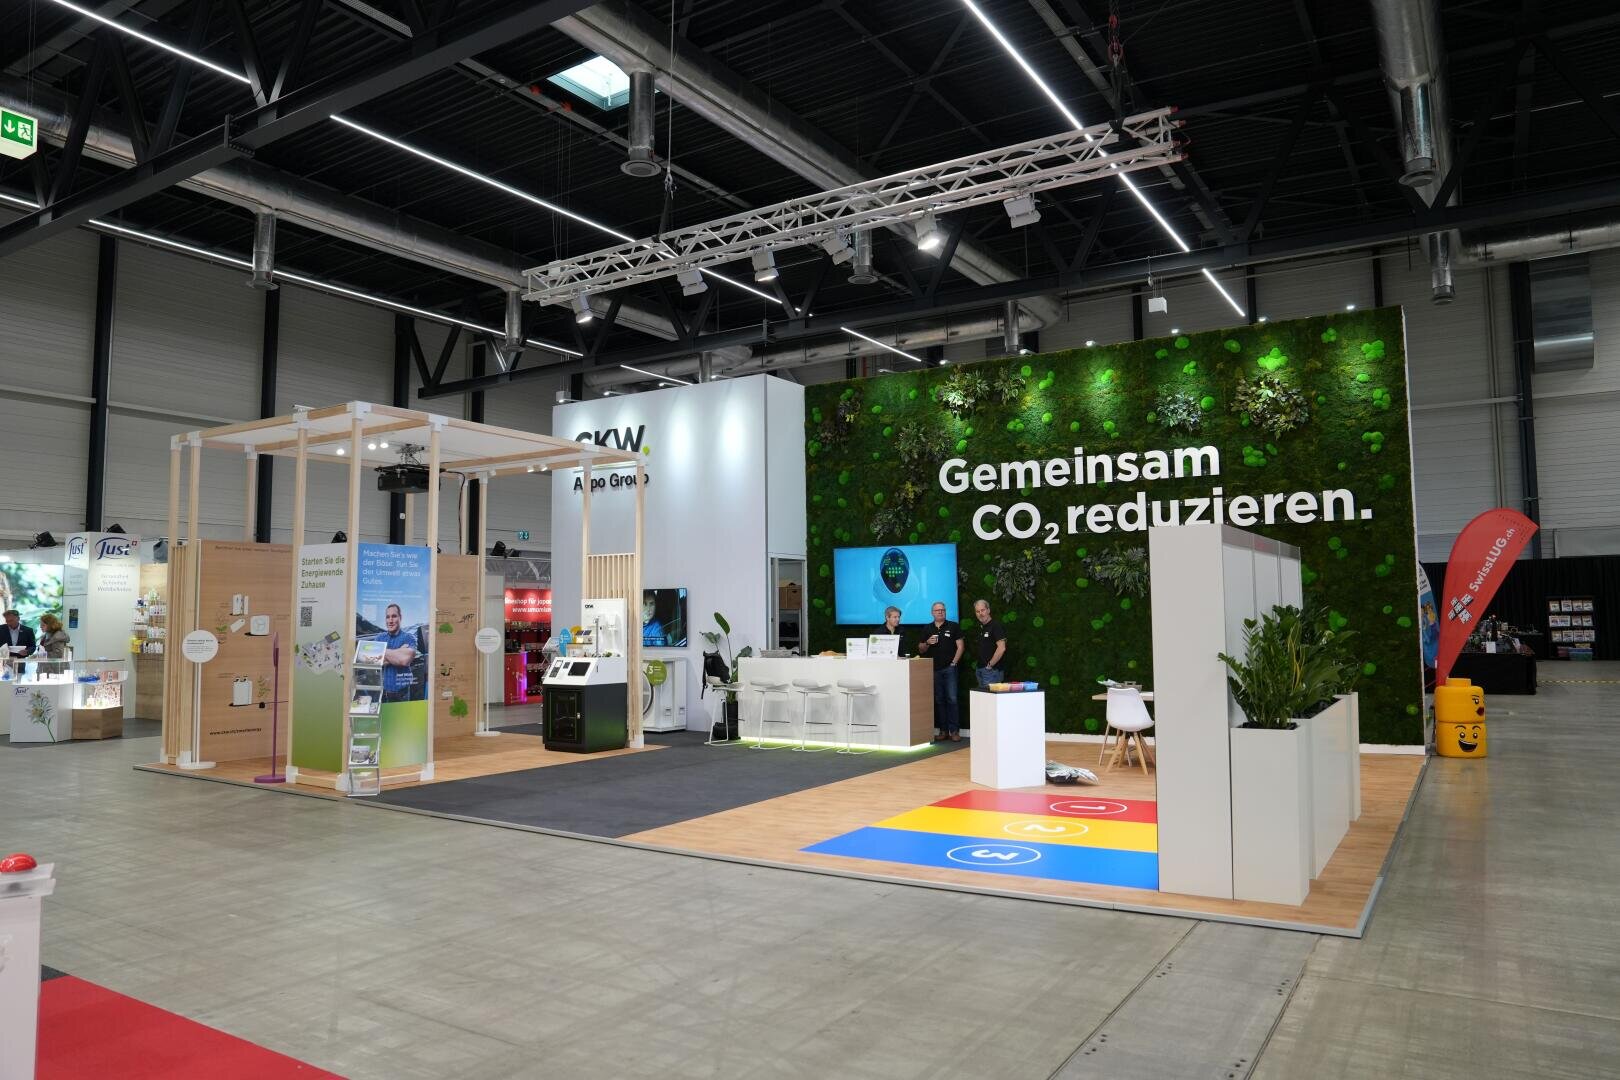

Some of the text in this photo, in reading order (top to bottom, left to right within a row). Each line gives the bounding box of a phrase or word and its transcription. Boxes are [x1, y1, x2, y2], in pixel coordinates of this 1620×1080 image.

[938, 445, 1221, 494] Gemeinsam
[573, 476, 606, 492] Apo
[1067, 486, 1373, 535] reduzieren.
[96, 539, 131, 560] Just
[301, 555, 345, 566] Starten Sie die
[1469, 528, 1515, 592] SwissLUG.ch
[301, 568, 344, 578] Energiewende
[300, 580, 326, 589] Zuhause
[1023, 823, 1066, 833] 2
[971, 849, 1019, 861] 3
